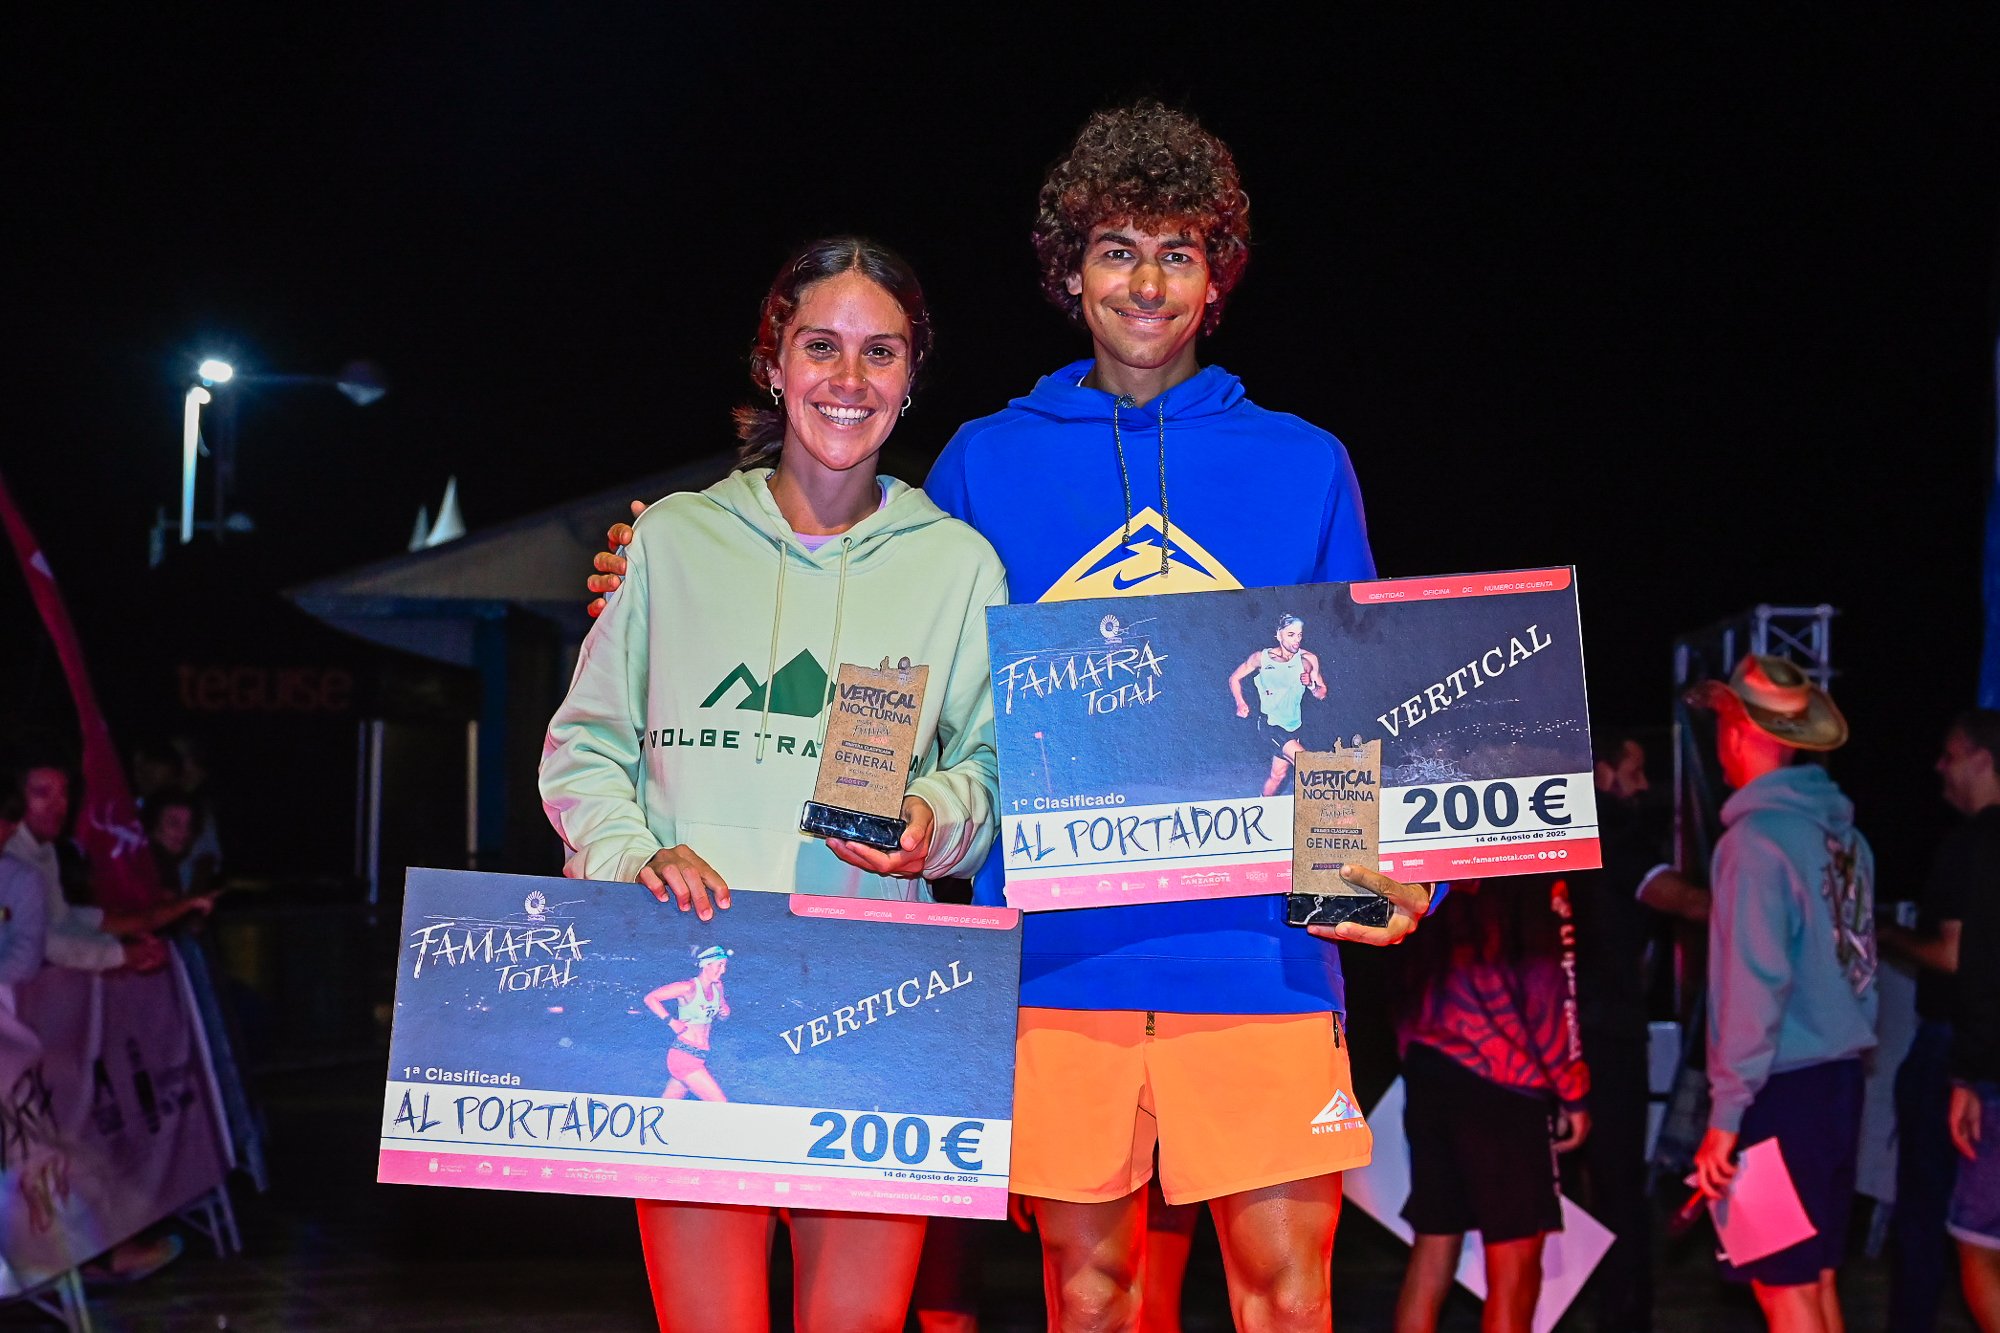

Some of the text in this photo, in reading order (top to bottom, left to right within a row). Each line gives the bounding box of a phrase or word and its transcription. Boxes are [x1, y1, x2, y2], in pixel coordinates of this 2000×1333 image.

[1368, 591, 1405, 600] IDENTIDAD
[1422, 588, 1450, 596] OFICINA
[1462, 586, 1473, 594] DC
[1515, 582, 1525, 590] DE
[1526, 580, 1553, 589] CUENTA
[996, 640, 1168, 715] FAMARA
[1377, 624, 1552, 737] VERTICAL
[840, 683, 916, 709] VERTICAL
[1082, 675, 1162, 715] TOTAL
[839, 700, 912, 726] NOCTURNA
[649, 728, 740, 749] VOLGE
[834, 750, 896, 773] GENERAL
[1299, 769, 1376, 791] VERTICAL
[1033, 793, 1125, 811] Clasificado
[1302, 788, 1375, 802] NOCTURNA
[1403, 777, 1572, 835] 200 €
[1010, 805, 1273, 863] AL PORTADOR
[1306, 837, 1367, 850] GENERAL
[1487, 834, 1498, 842] de
[1500, 832, 1531, 843] Agosto
[1532, 831, 1544, 839] de
[1546, 830, 1567, 838] 2025
[1451, 852, 1535, 866] www.famaratotal.com
[1180, 875, 1231, 885] LANZAROTE
[807, 906, 845, 916] IDENTIDAD
[863, 910, 893, 919] OFICINA
[960, 916, 970, 924] DE
[971, 917, 1000, 926] CUENTA
[409, 922, 592, 979] FAMARA
[495, 958, 578, 993] TOTAL
[779, 960, 973, 1055] VERTICAL
[425, 1067, 521, 1086] Clasificada
[392, 1088, 670, 1146] AL PORTADOR
[1311, 1123, 1341, 1135] NIKE
[806, 1111, 985, 1171] 200 €
[565, 1173, 618, 1181] LANZAROTE
[895, 1171, 907, 1179] de
[909, 1172, 941, 1181] Agosto
[943, 1174, 955, 1182] de
[957, 1175, 979, 1183] 2025
[850, 1189, 939, 1202] www.famaratotal.com
